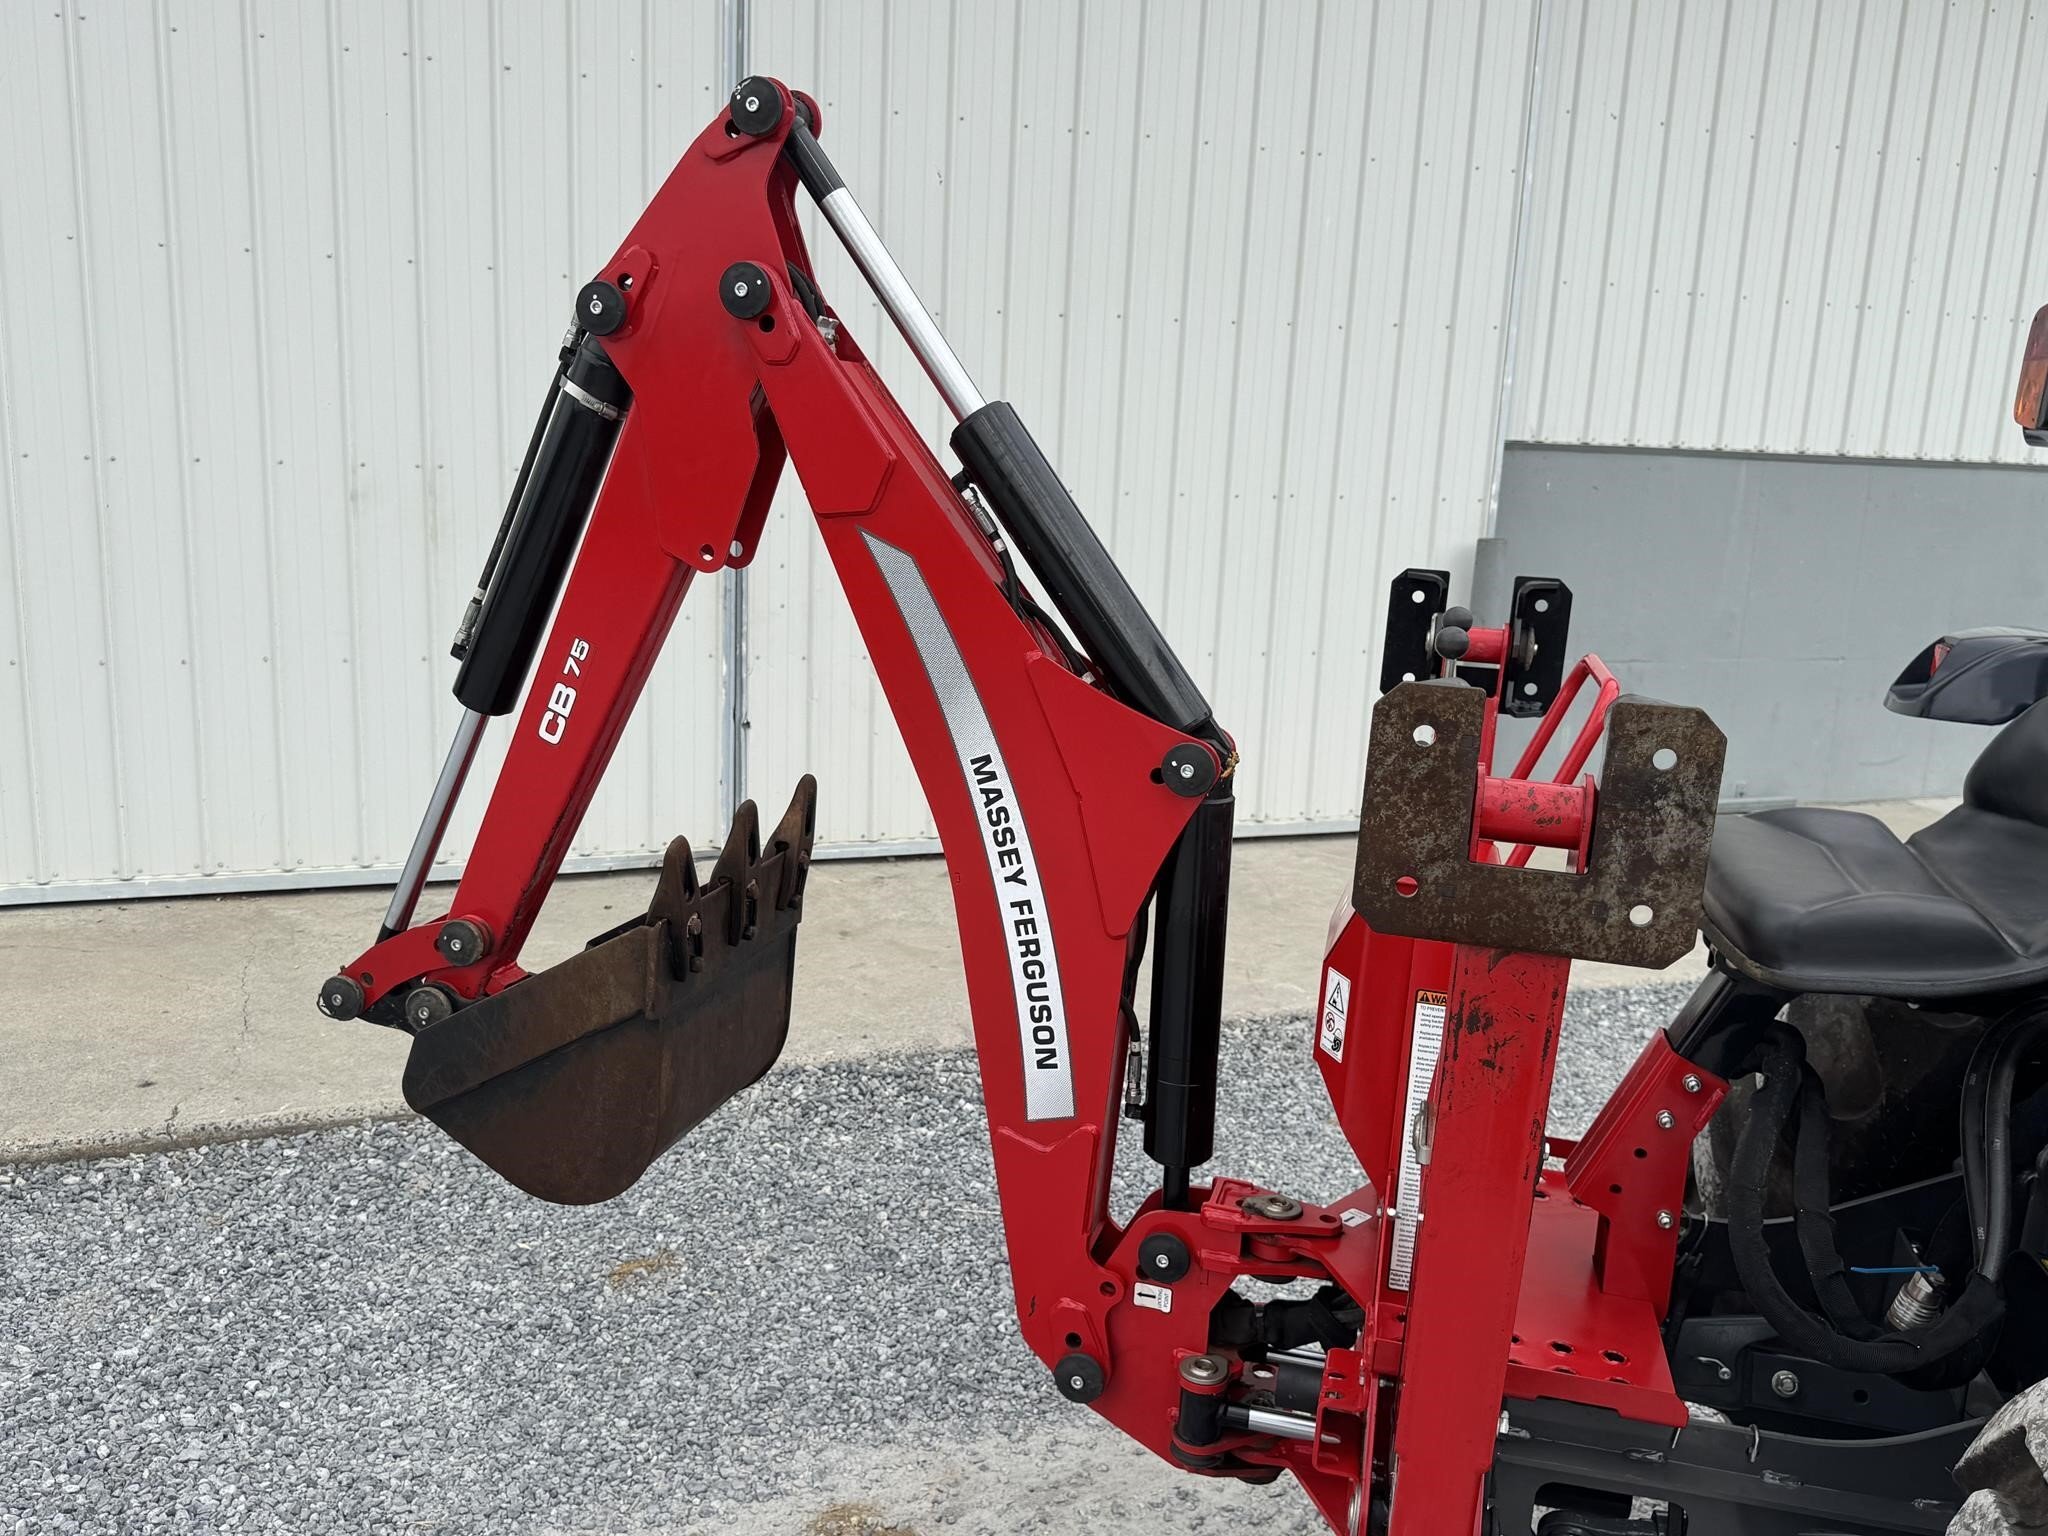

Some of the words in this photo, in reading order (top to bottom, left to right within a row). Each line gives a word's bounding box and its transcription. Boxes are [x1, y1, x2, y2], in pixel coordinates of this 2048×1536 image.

[538, 682, 577, 745] CB
[562, 638, 590, 678] 75
[969, 753, 1028, 888] MASSEY
[1009, 899, 1059, 1071] FERGUSON
